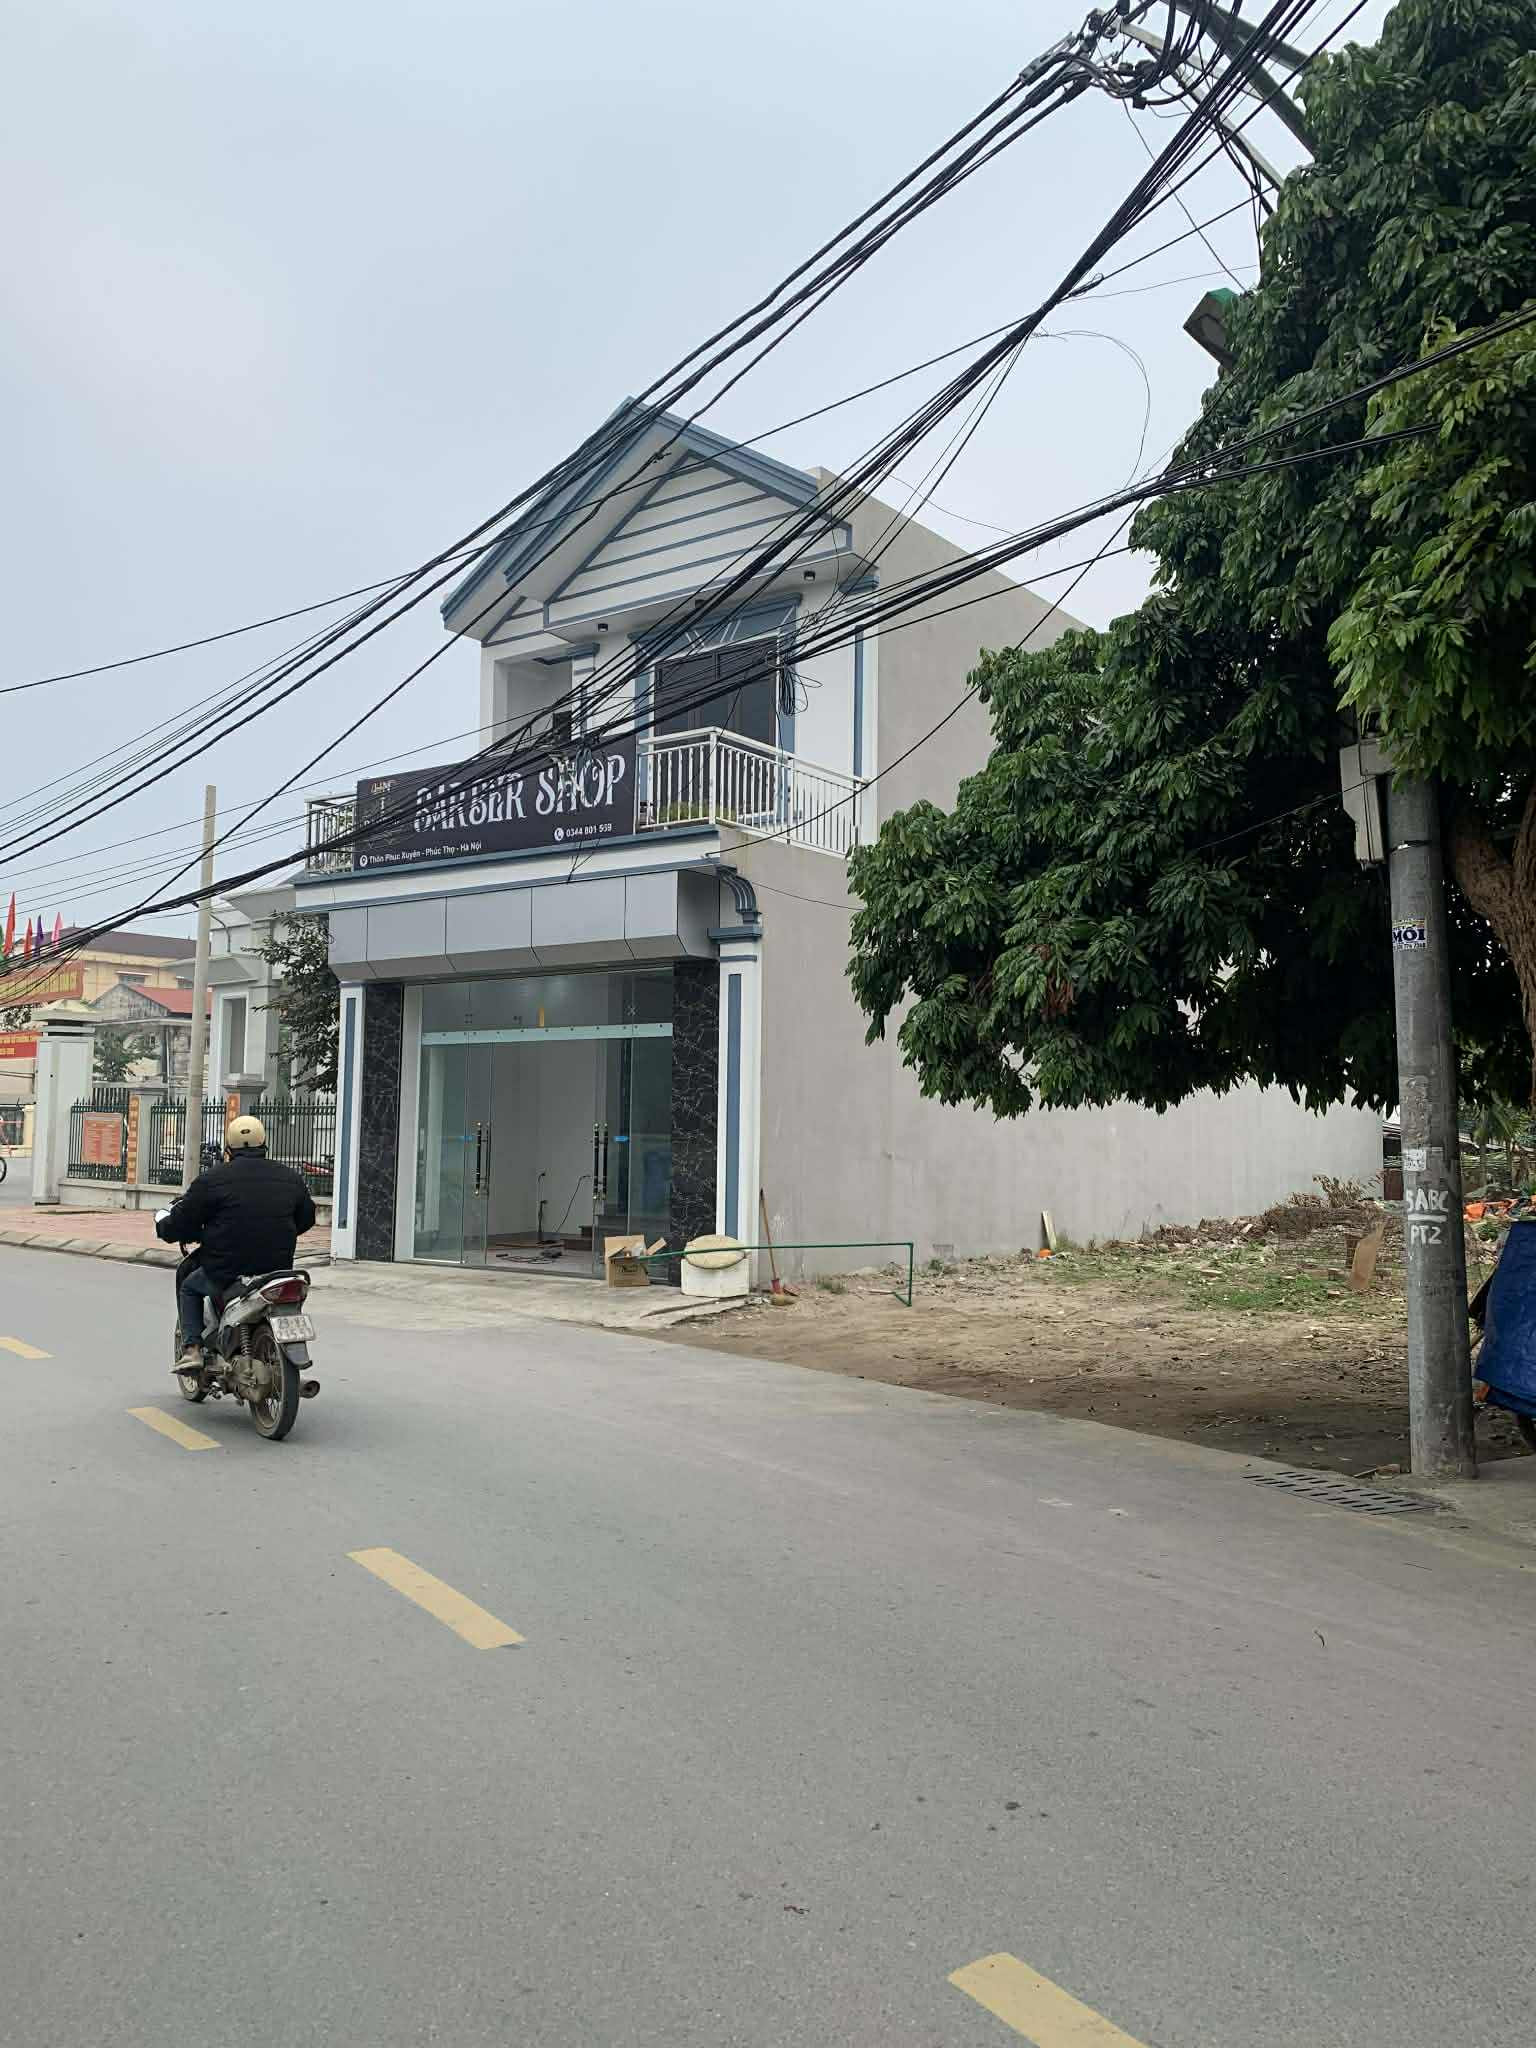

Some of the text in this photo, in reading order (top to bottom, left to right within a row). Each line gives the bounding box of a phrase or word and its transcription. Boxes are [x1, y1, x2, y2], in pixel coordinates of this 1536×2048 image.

[536, 755, 626, 815] SHOP
[566, 827, 583, 837] 0344
[1411, 1224, 1442, 1245] PT2
